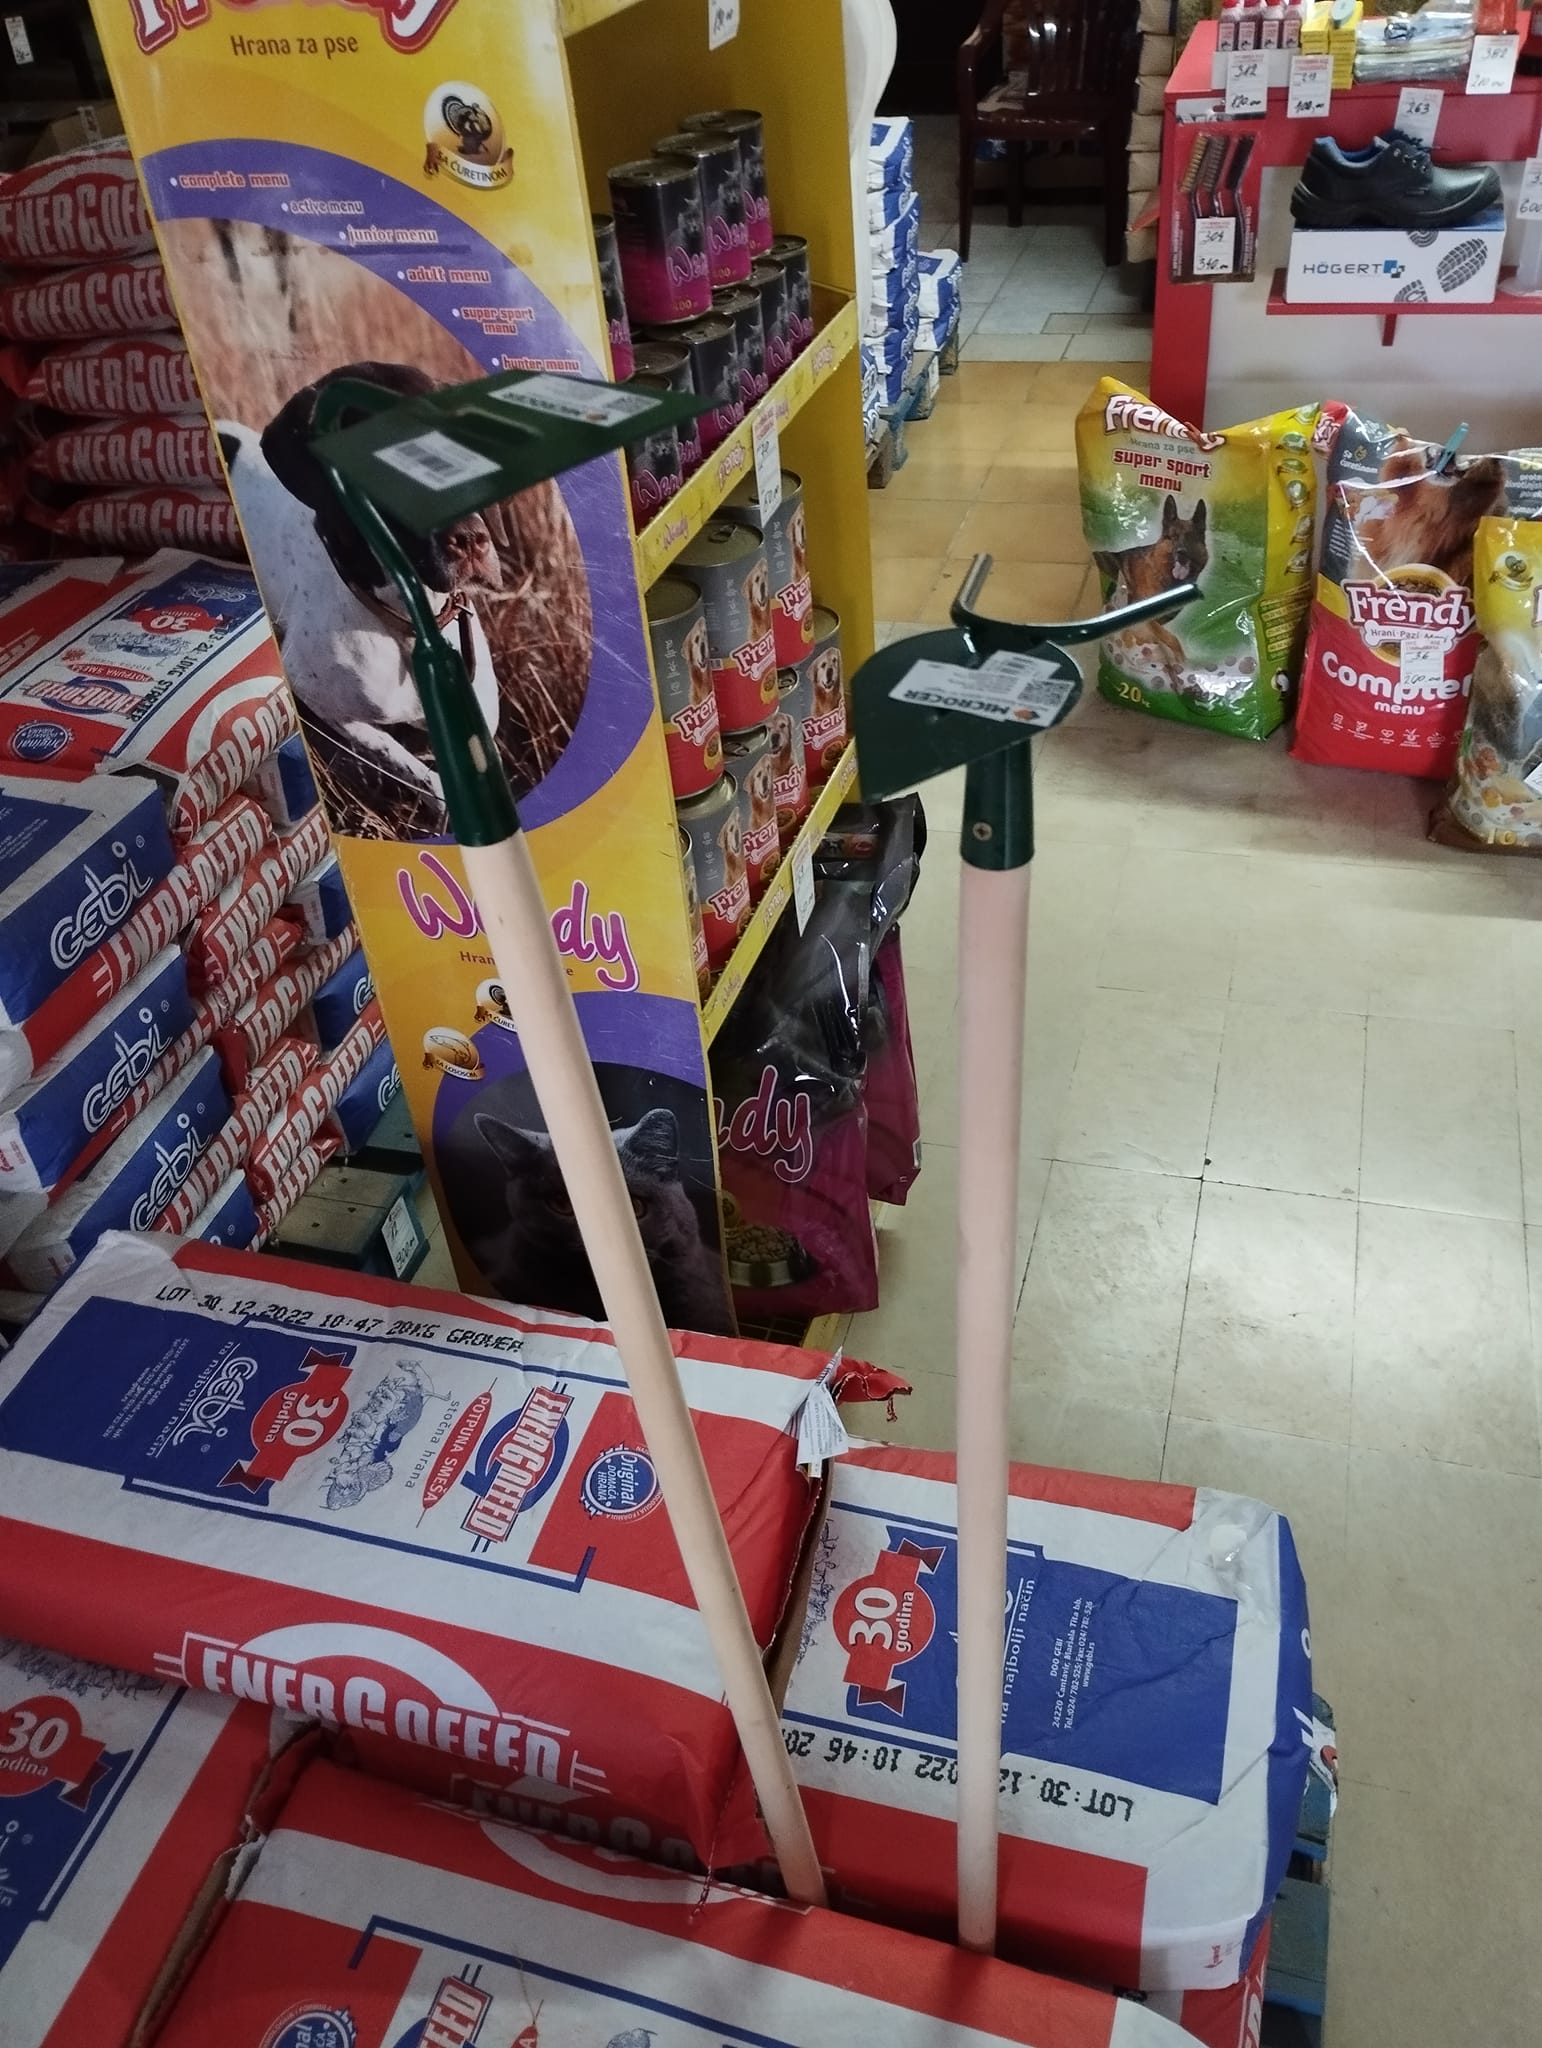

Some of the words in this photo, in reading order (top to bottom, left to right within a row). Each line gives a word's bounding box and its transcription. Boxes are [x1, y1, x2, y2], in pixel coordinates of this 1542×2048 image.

[230, 35, 291, 57] Hrana
[298, 38, 318, 55] za
[325, 35, 360, 60] pse
[180, 171, 246, 192] complete
[250, 173, 290, 188] menu
[289, 199, 328, 215] active
[327, 200, 365, 215] menu
[347, 224, 395, 248] junior
[394, 228, 439, 244] menu
[406, 265, 447, 283] adult
[449, 269, 492, 284] menu
[1303, 261, 1382, 275] HÖGERT
[461, 307, 499, 322] super
[499, 307, 535, 323] sport
[483, 322, 518, 335] menu
[501, 354, 543, 371] hunter
[544, 357, 582, 372] menu
[1113, 449, 1162, 468] super
[1166, 458, 1211, 478] sport
[1139, 473, 1182, 492] menu
[150, 615, 196, 632] 30
[1345, 586, 1476, 634] Frendy
[1373, 700, 1426, 716] menu
[217, 1341, 235, 1357] na
[178, 1359, 219, 1413] najbolji
[263, 1390, 299, 1444] godina
[281, 1393, 340, 1448] 30
[430, 1399, 461, 1444] stočna
[449, 1396, 490, 1453] POTPUNA
[145, 1415, 179, 1457] način
[404, 1449, 436, 1489] hrana
[423, 1453, 458, 1502] SMEŠA
[469, 1391, 569, 1537] ENERGOFEED
[597, 1470, 608, 1501] HRANA
[616, 1454, 640, 1506] Original
[847, 1586, 900, 1652] 30
[894, 1589, 916, 1654] godina
[1003, 1627, 1026, 1695] najbolji
[1018, 1579, 1036, 1623] način
[1053, 1638, 1064, 1659] GEBI
[1049, 1657, 1060, 1678] DOO
[201, 1646, 561, 1786] ENERGOFEED
[1051, 1699, 1064, 1729] 24220
[3, 1710, 69, 1760] 30
[823, 1737, 902, 1773] 10:46
